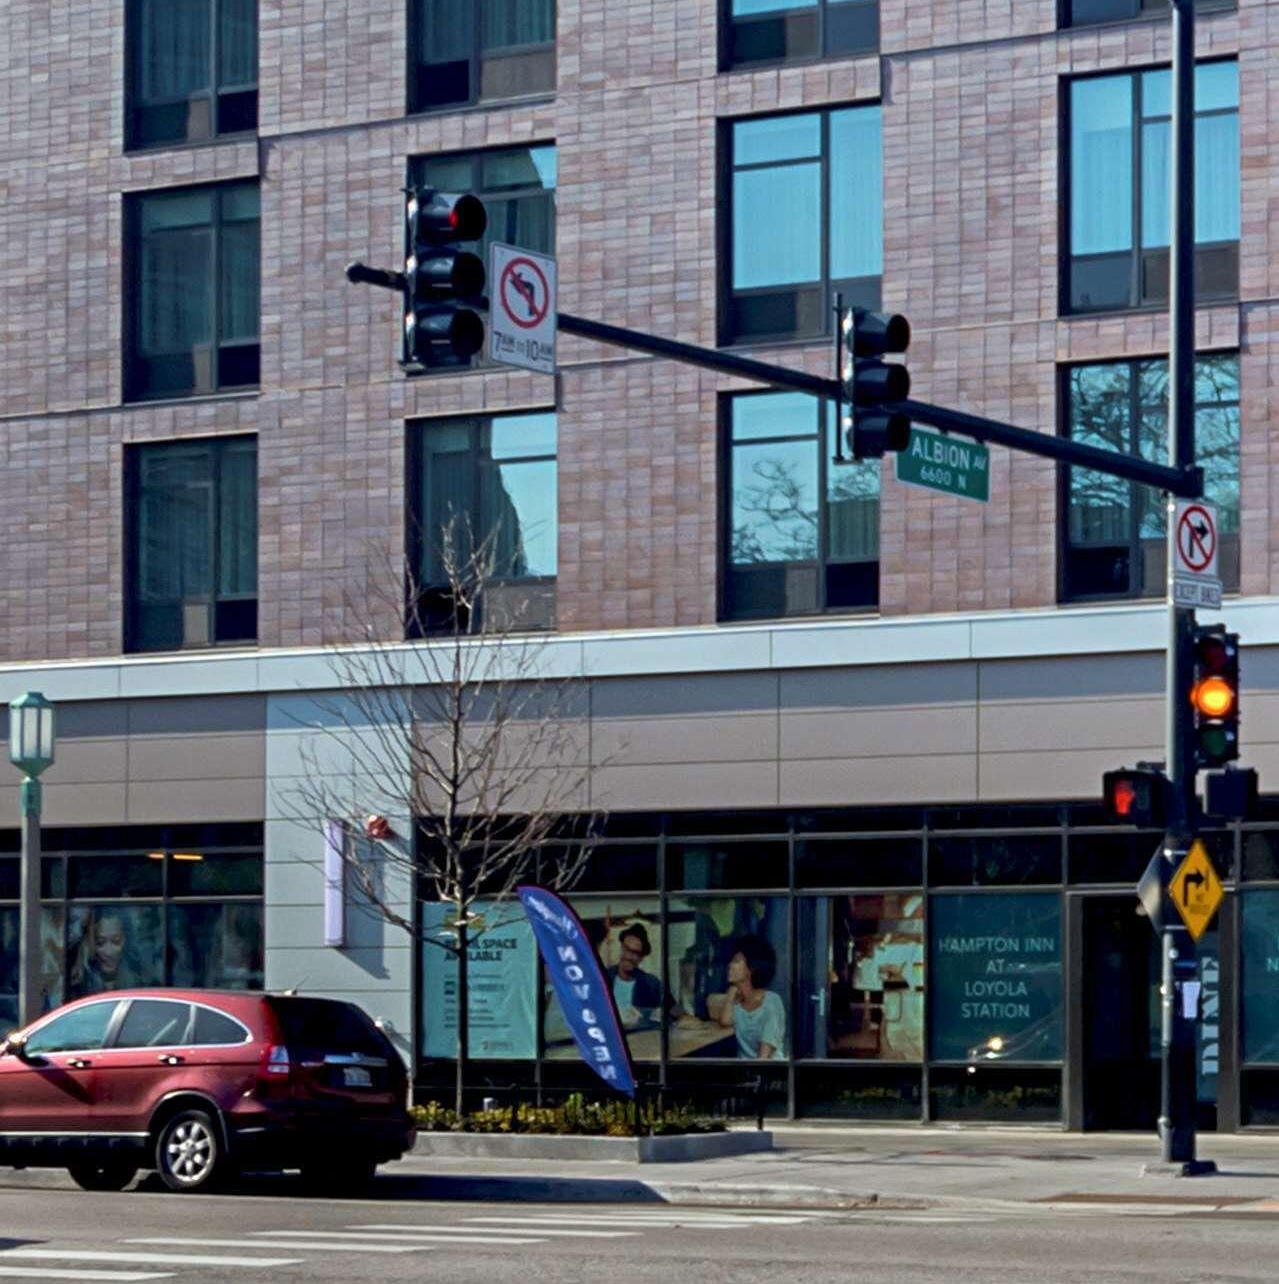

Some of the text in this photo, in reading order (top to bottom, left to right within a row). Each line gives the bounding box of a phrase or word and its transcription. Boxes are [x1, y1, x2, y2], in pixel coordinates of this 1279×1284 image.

[911, 435, 971, 470] ALBION
[920, 464, 967, 490] 6600 N
[483, 938, 517, 949] SPACE
[939, 937, 1054, 953] HAMPTON INN
[986, 959, 1005, 974] AT
[964, 980, 1028, 997] LOYOLA
[961, 1002, 1030, 1018] STATION
